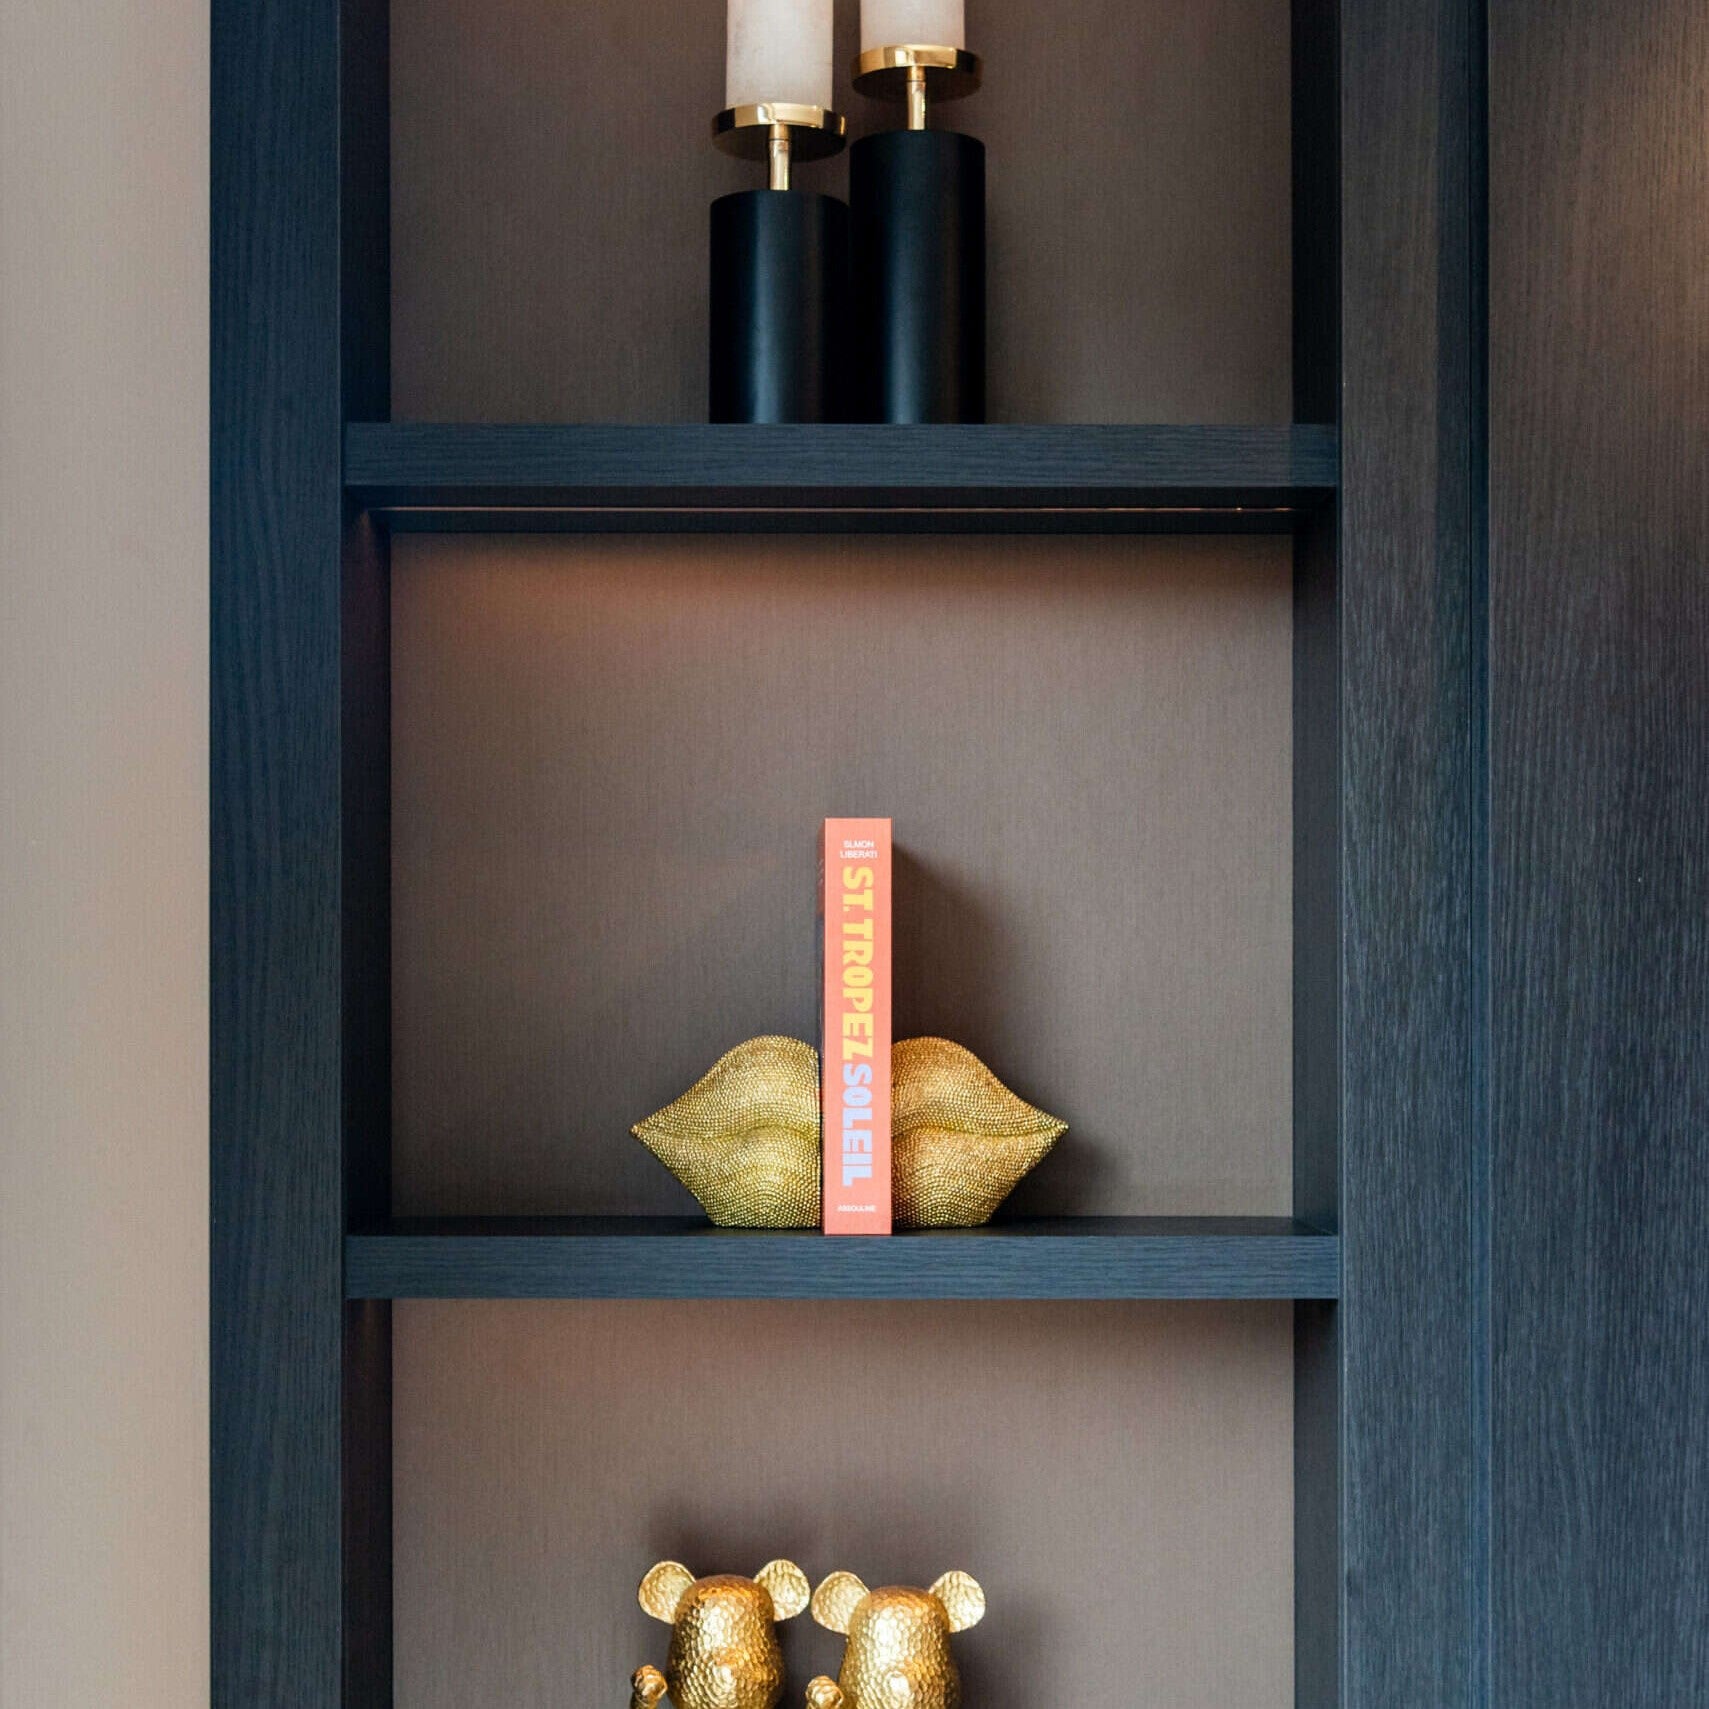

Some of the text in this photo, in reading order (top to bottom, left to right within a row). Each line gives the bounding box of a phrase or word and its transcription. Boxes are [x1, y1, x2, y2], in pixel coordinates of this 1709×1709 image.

[840, 849, 878, 859] LIBERATI
[842, 866, 874, 1187] ST. TROPEZ SOLEIL
